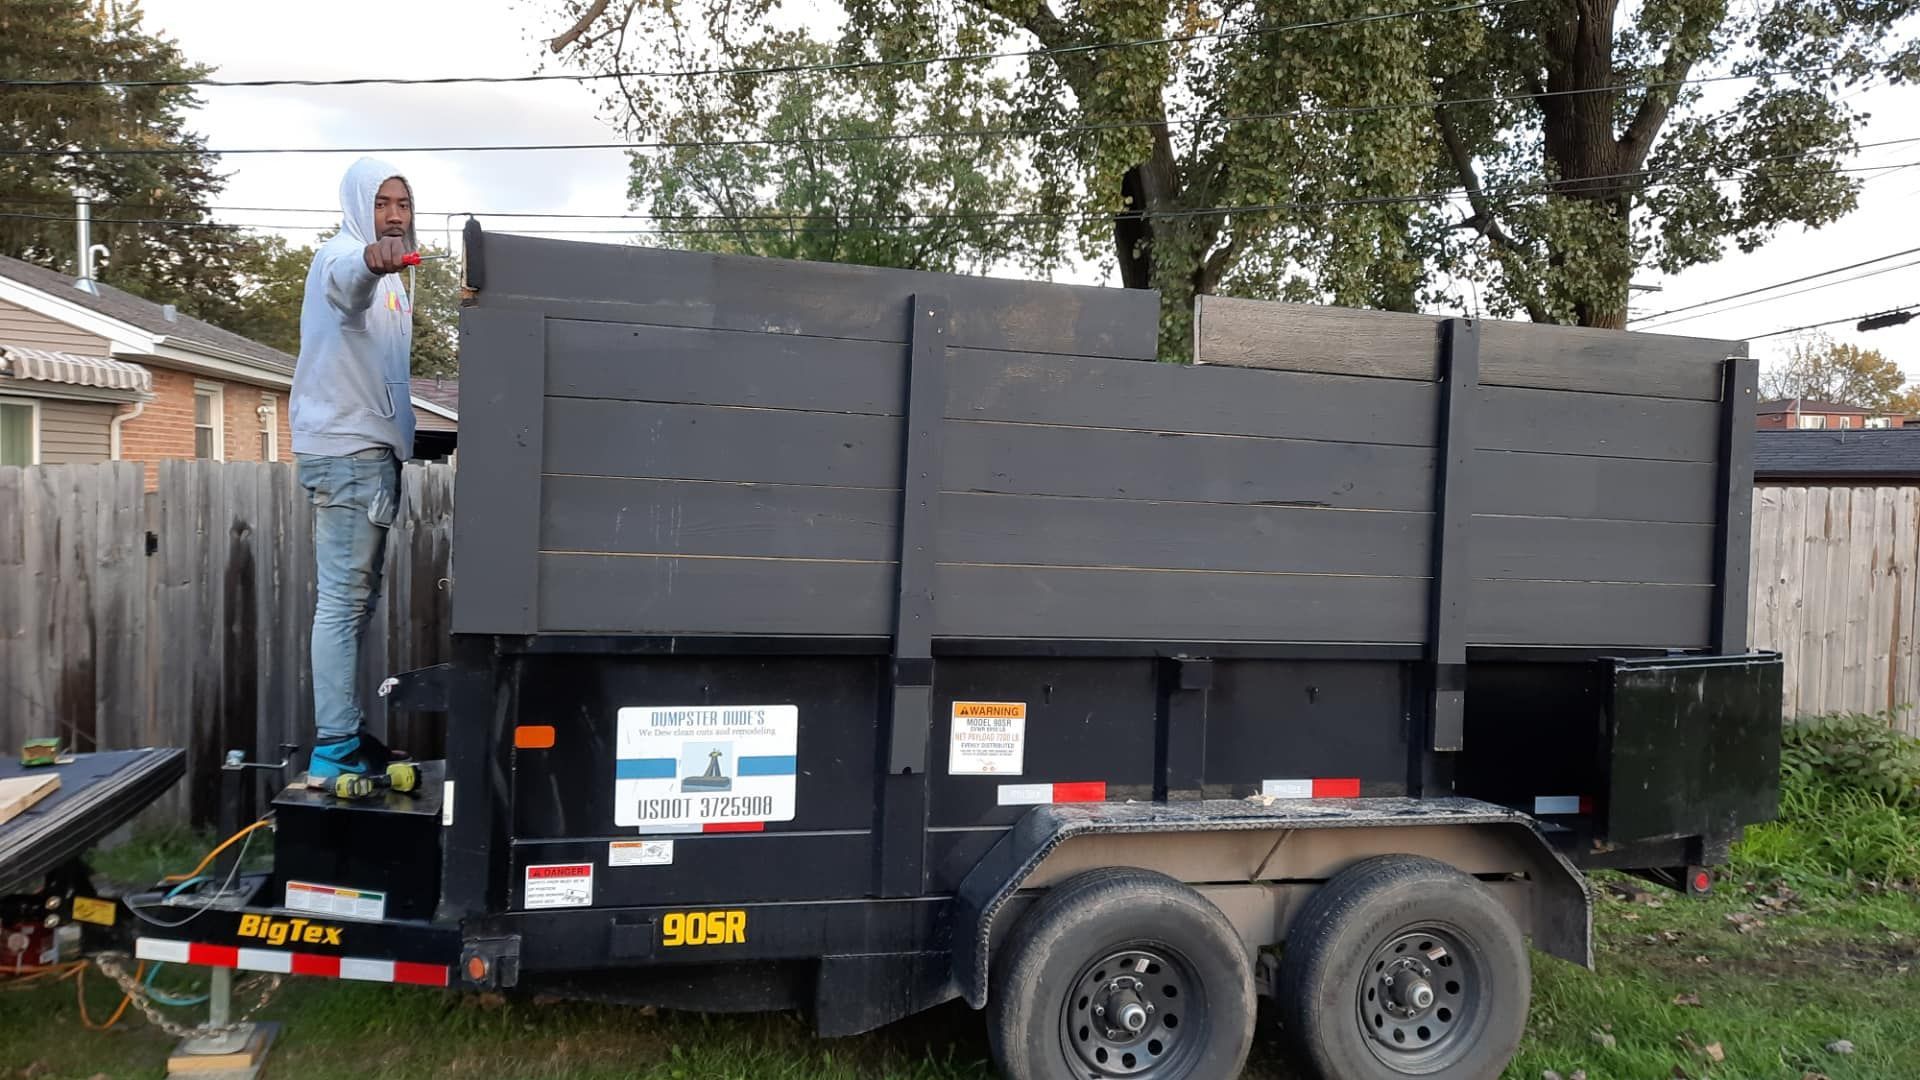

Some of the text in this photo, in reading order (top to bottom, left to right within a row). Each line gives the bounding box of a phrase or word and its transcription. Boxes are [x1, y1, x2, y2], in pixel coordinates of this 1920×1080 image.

[970, 706, 1019, 716] WARNING
[651, 710, 765, 727] DUMPSTER DUDE'S
[967, 719, 991, 727] MODEL
[639, 729, 652, 737] We
[673, 728, 695, 736] clean
[715, 727, 731, 736] and
[732, 727, 776, 738] remodeling
[638, 796, 772, 820] USDOT 3725908
[544, 867, 584, 878] DANGER
[237, 914, 344, 946] BigTex
[663, 911, 746, 947] 90SR
